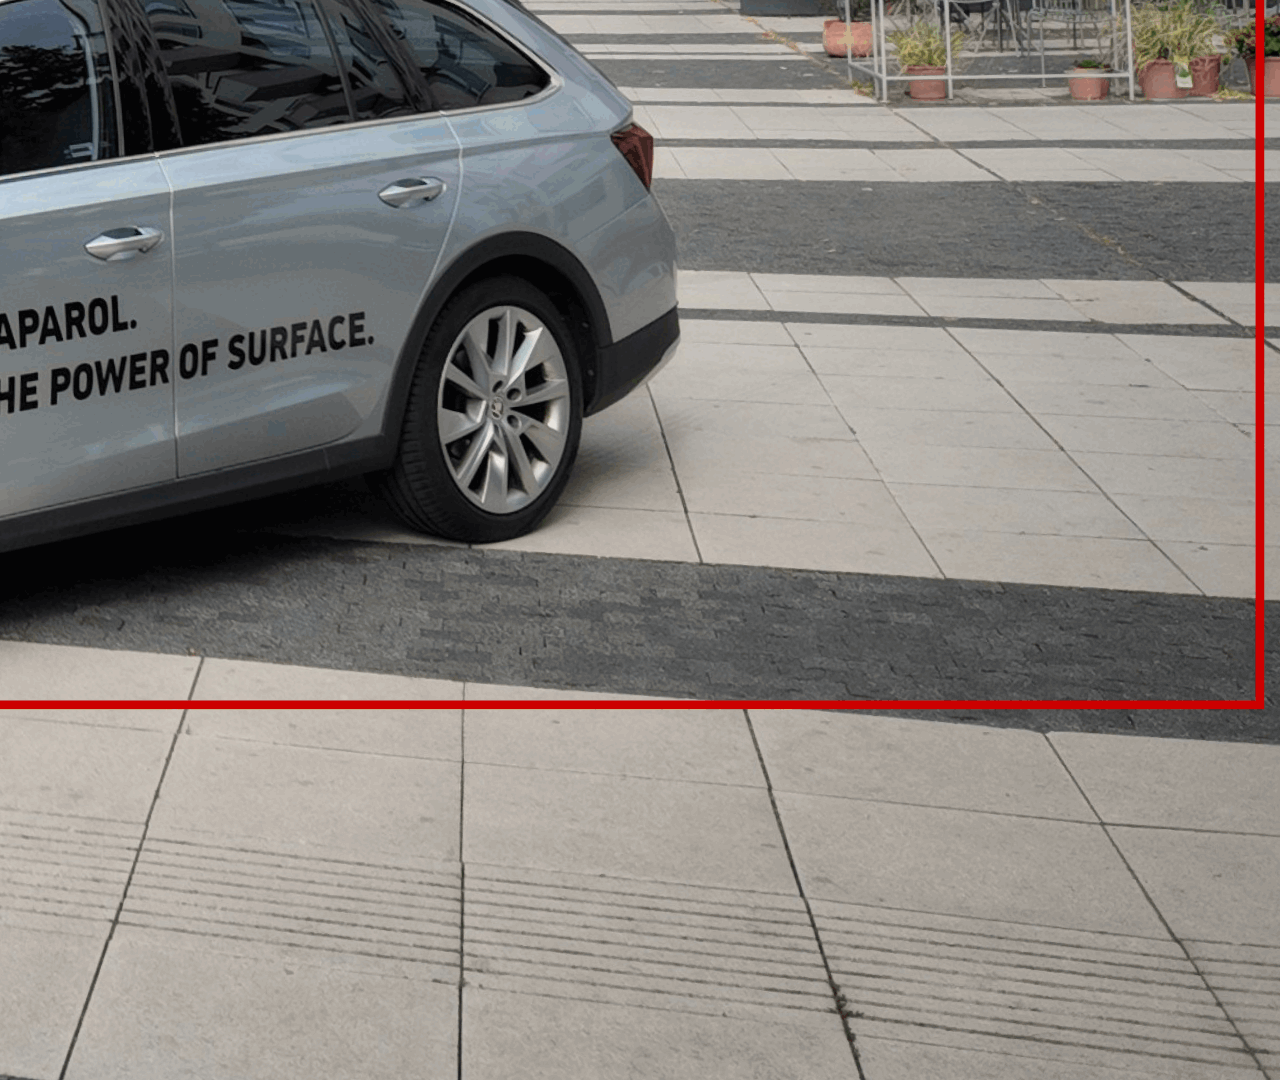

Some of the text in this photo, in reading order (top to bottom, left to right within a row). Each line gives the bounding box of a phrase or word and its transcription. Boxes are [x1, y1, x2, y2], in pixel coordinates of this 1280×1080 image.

[49, 348, 170, 406] POWER
[178, 338, 219, 380] OF
[226, 311, 375, 370] SURFACE.
